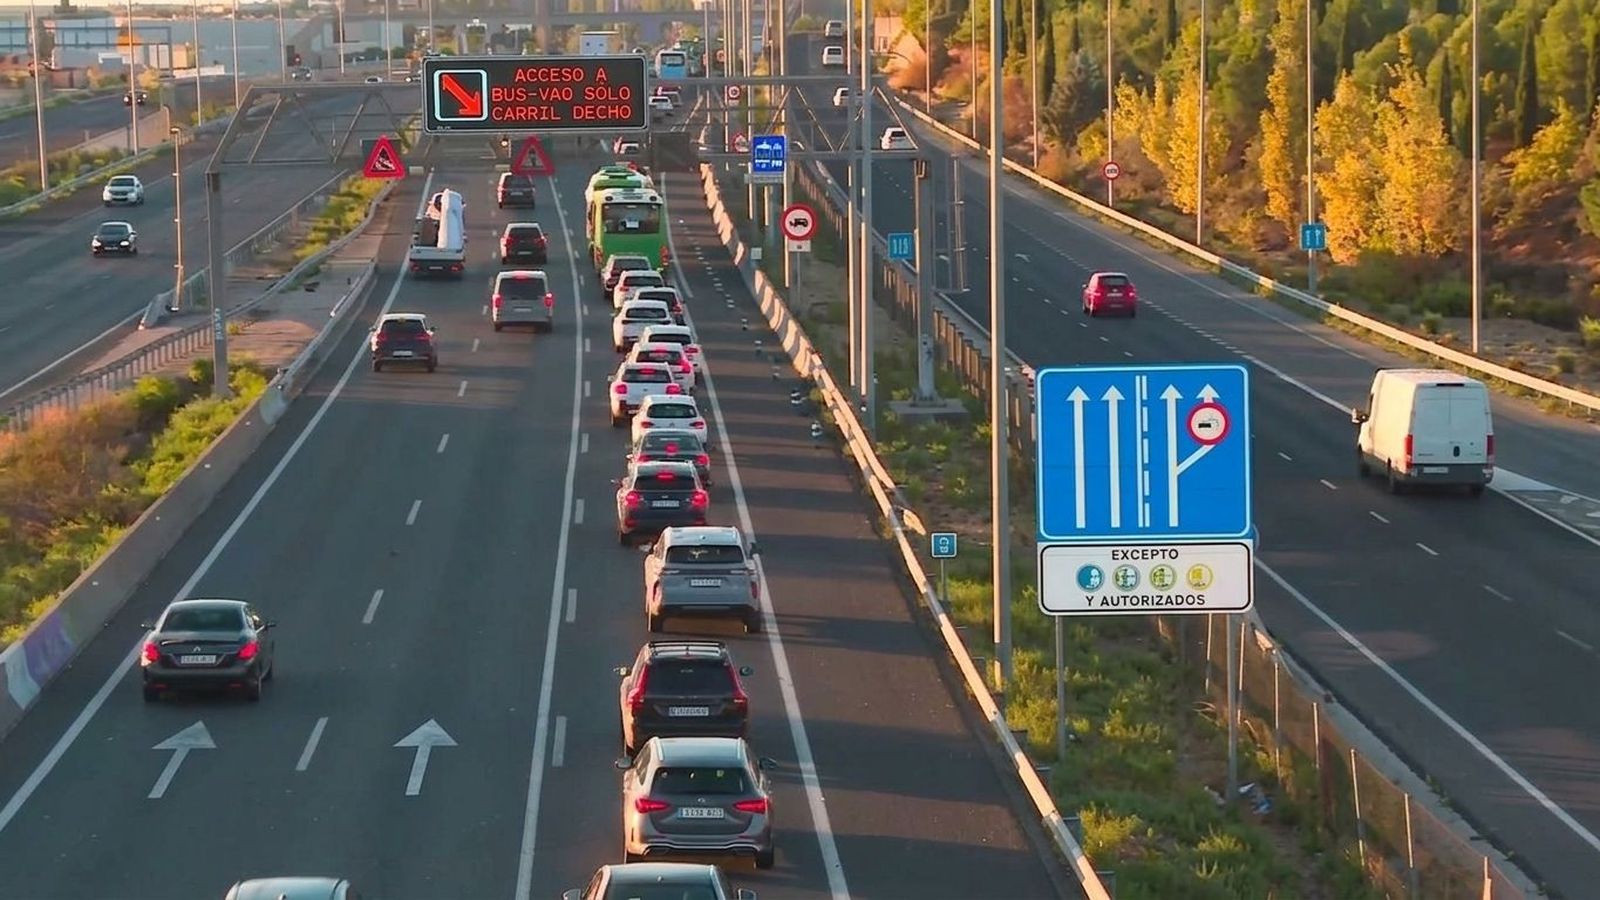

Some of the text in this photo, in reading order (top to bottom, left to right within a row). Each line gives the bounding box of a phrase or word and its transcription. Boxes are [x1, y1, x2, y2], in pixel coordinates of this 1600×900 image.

[515, 67, 607, 82] ACCESO A
[492, 87, 573, 102] BUS-VAO
[492, 105, 632, 121] CARRIL DECHO
[1111, 549, 1179, 560] EXCEPTO
[1085, 594, 1205, 607] Y AUTORIZADOS
